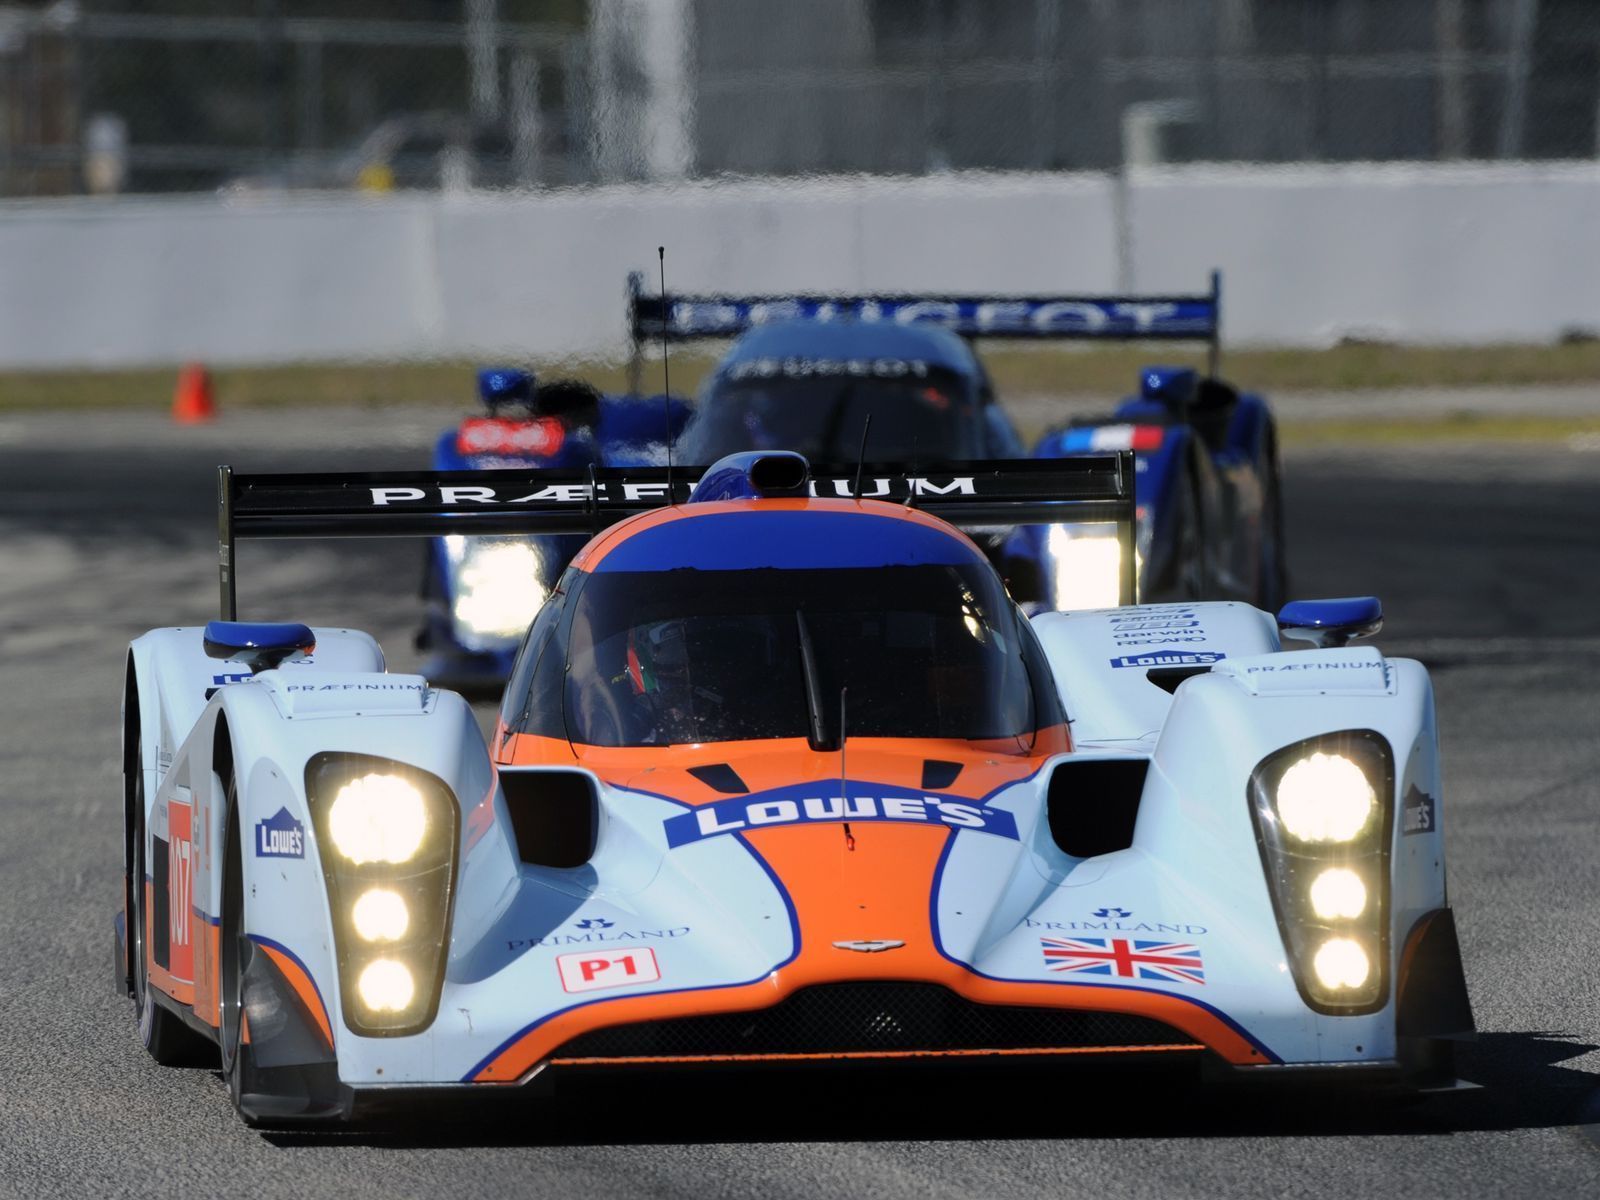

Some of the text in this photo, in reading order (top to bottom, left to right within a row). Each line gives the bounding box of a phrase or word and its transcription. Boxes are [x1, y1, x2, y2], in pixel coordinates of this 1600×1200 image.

[1113, 629, 1204, 638] darwin
[1117, 637, 1206, 646] RECARO
[1121, 654, 1217, 667] LOWE'S
[695, 796, 986, 836] LOWE'S
[262, 825, 302, 855] LOWE'S
[1024, 917, 1208, 935] PRIMLAND
[506, 927, 691, 951] PRIMLAND
[579, 956, 637, 982] P1
